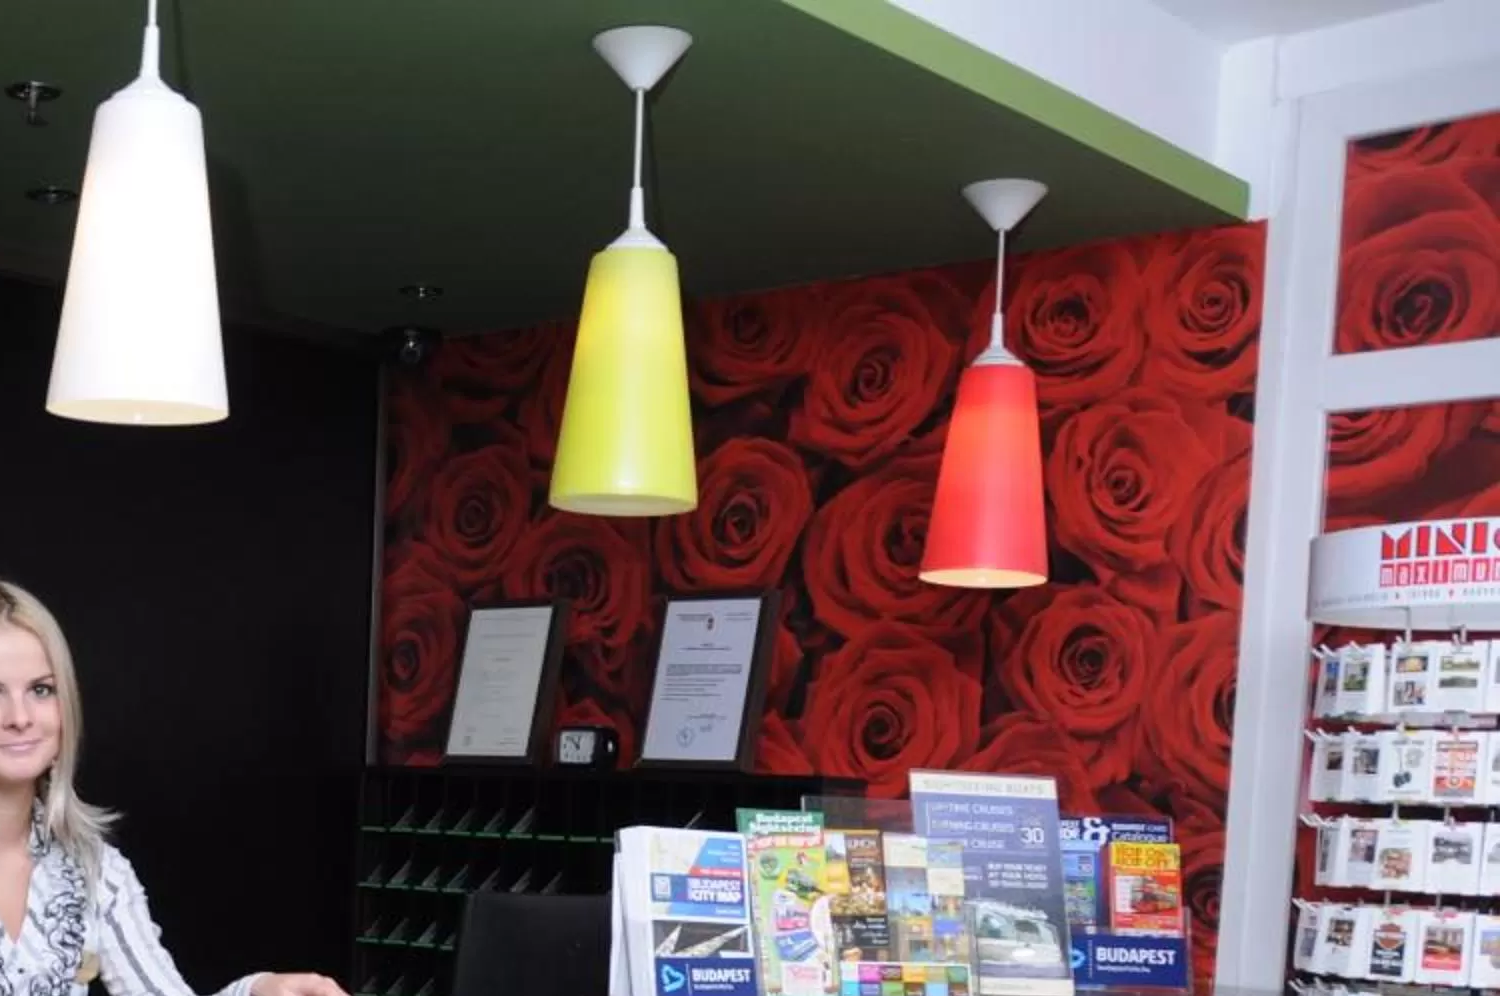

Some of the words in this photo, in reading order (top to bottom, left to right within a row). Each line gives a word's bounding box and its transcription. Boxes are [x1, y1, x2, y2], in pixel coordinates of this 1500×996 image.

[1381, 522, 1500, 560] MINI
[1020, 827, 1045, 844] 30
[1095, 947, 1177, 966] BUDAPEST
[691, 967, 751, 984] BUDAPEST
